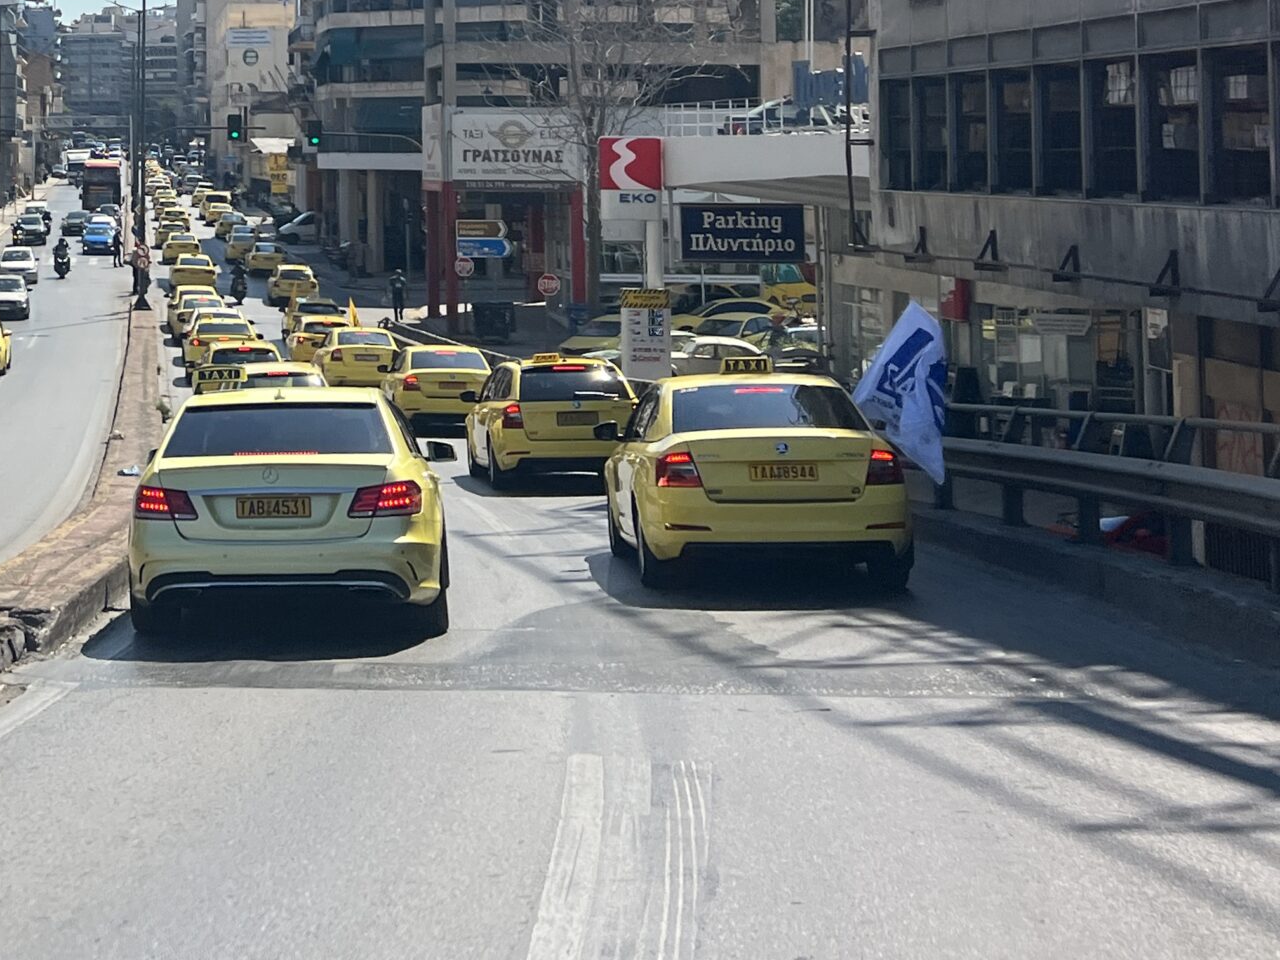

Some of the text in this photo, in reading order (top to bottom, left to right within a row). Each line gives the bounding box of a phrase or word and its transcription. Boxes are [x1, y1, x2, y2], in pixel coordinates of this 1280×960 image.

[462, 128, 484, 140] ΤΑΞΙ
[462, 149, 564, 163] ΓΡΑΤΣΟΥΝΑΣ
[619, 193, 657, 204] EKO
[702, 211, 782, 233] Parking
[690, 233, 796, 256] Πλυντήριο
[539, 279, 559, 290] STOP
[727, 360, 766, 372] TAXI
[203, 370, 235, 380] TAXI
